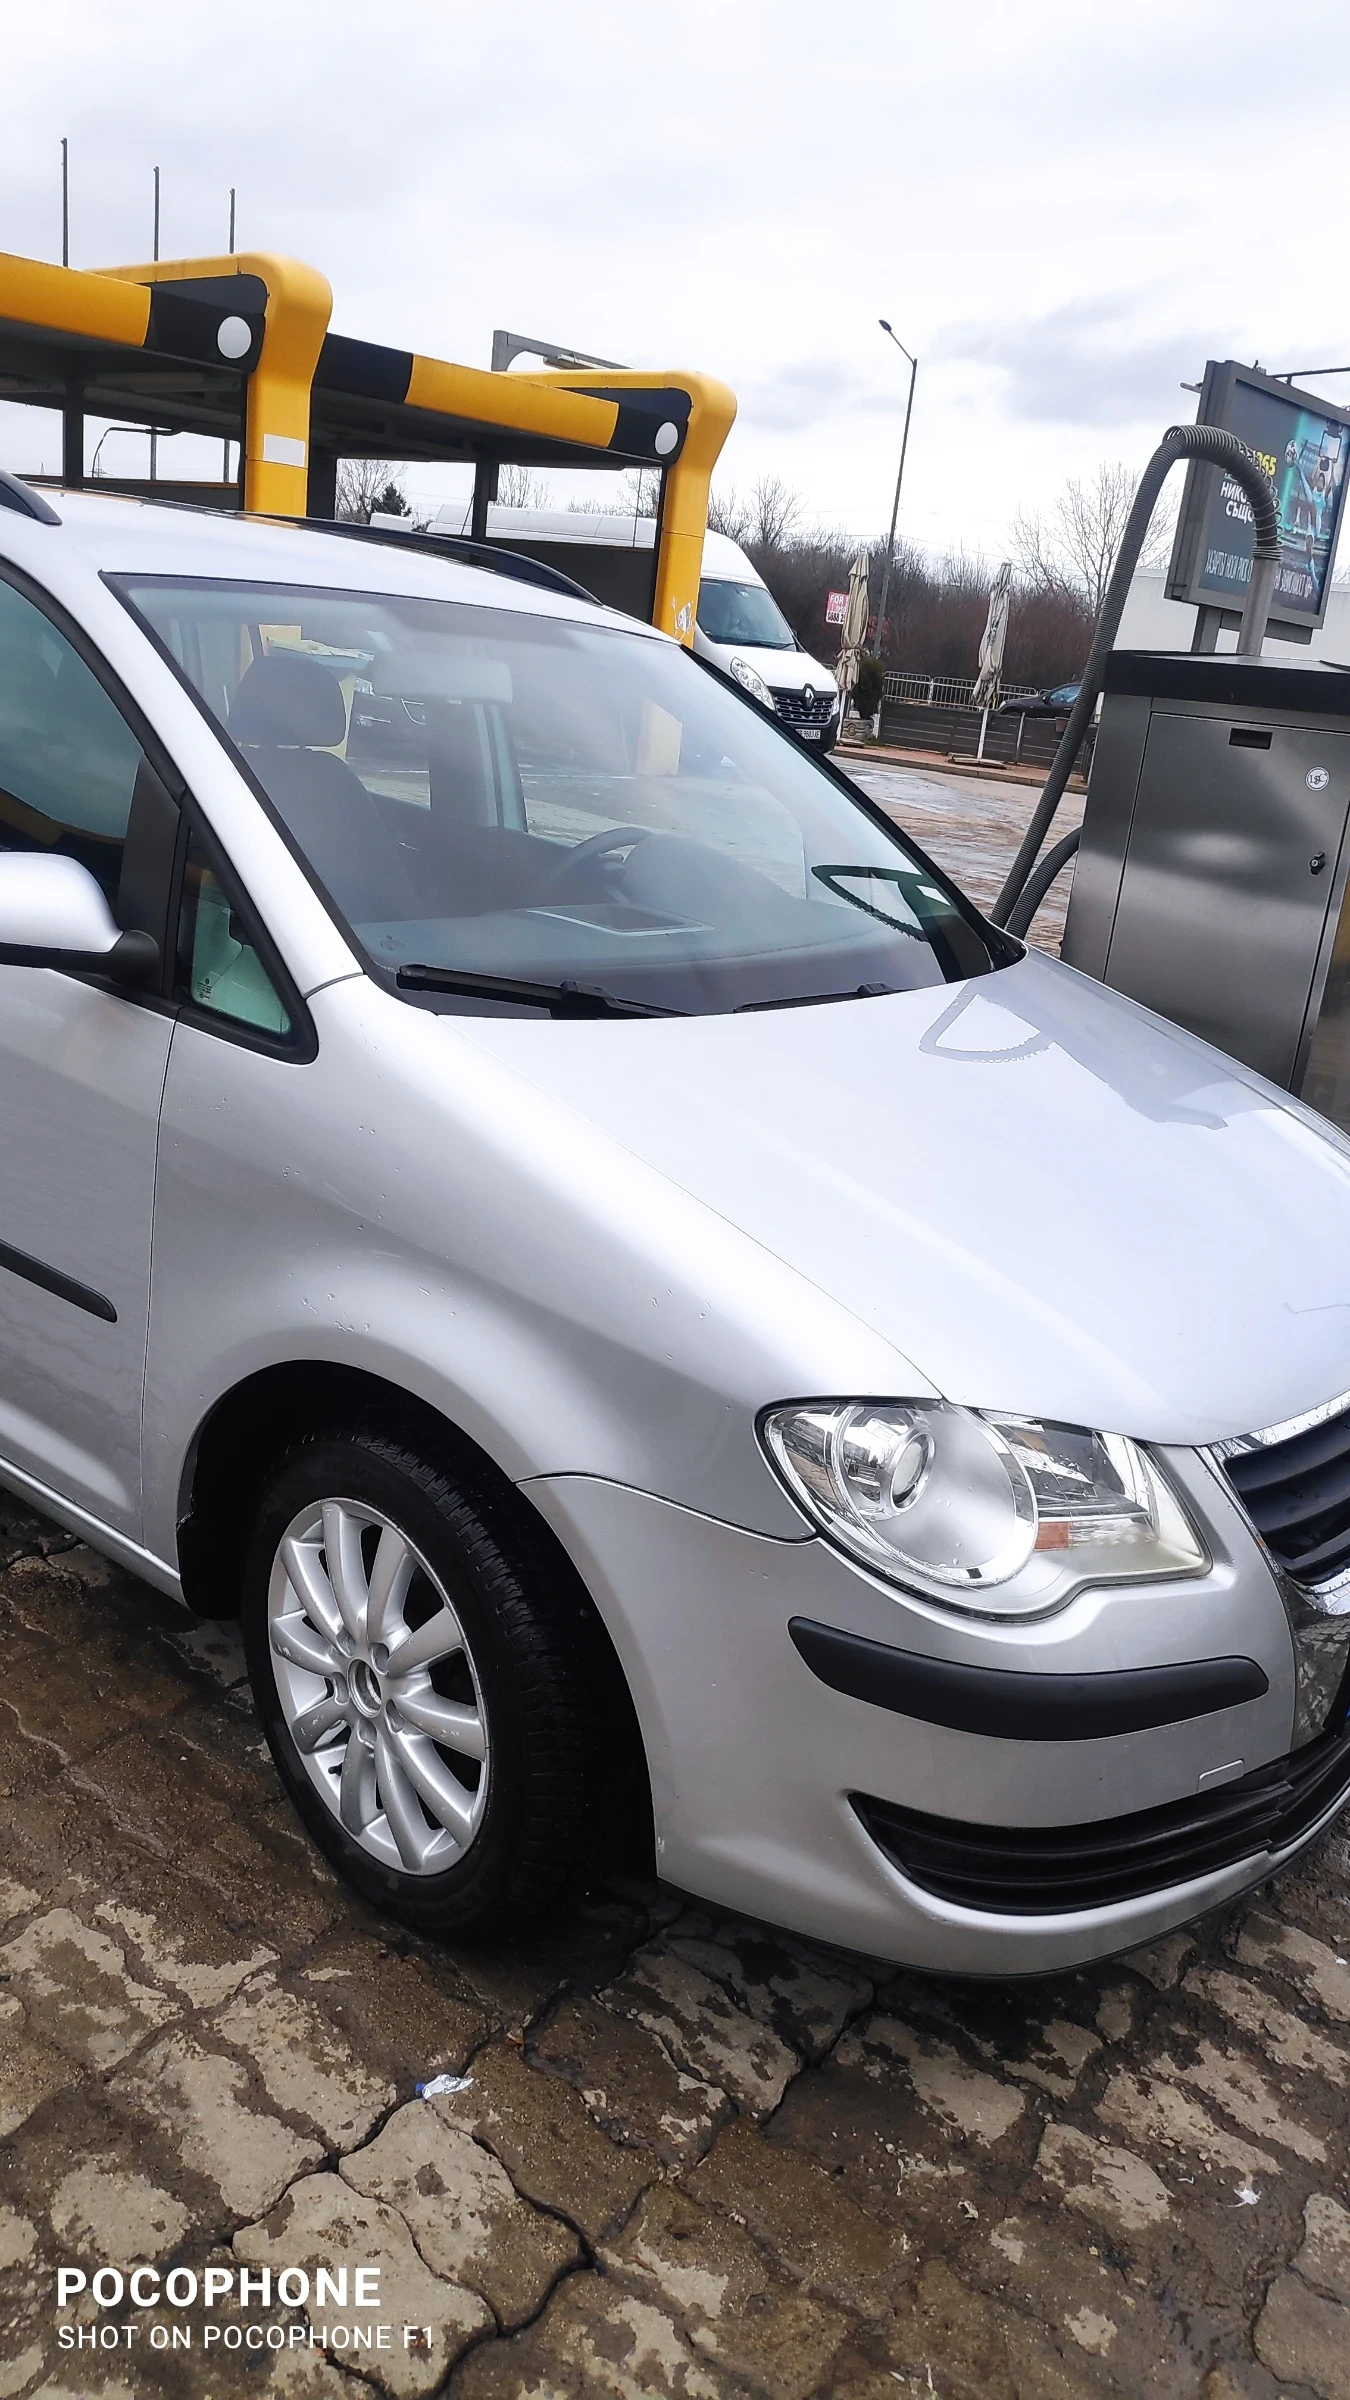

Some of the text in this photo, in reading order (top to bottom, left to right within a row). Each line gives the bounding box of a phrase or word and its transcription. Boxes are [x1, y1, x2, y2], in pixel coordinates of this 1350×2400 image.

[1220, 481, 1248, 503] НИКО
[1225, 501, 1256, 524] СЪЩО
[830, 594, 844, 605] FOR
